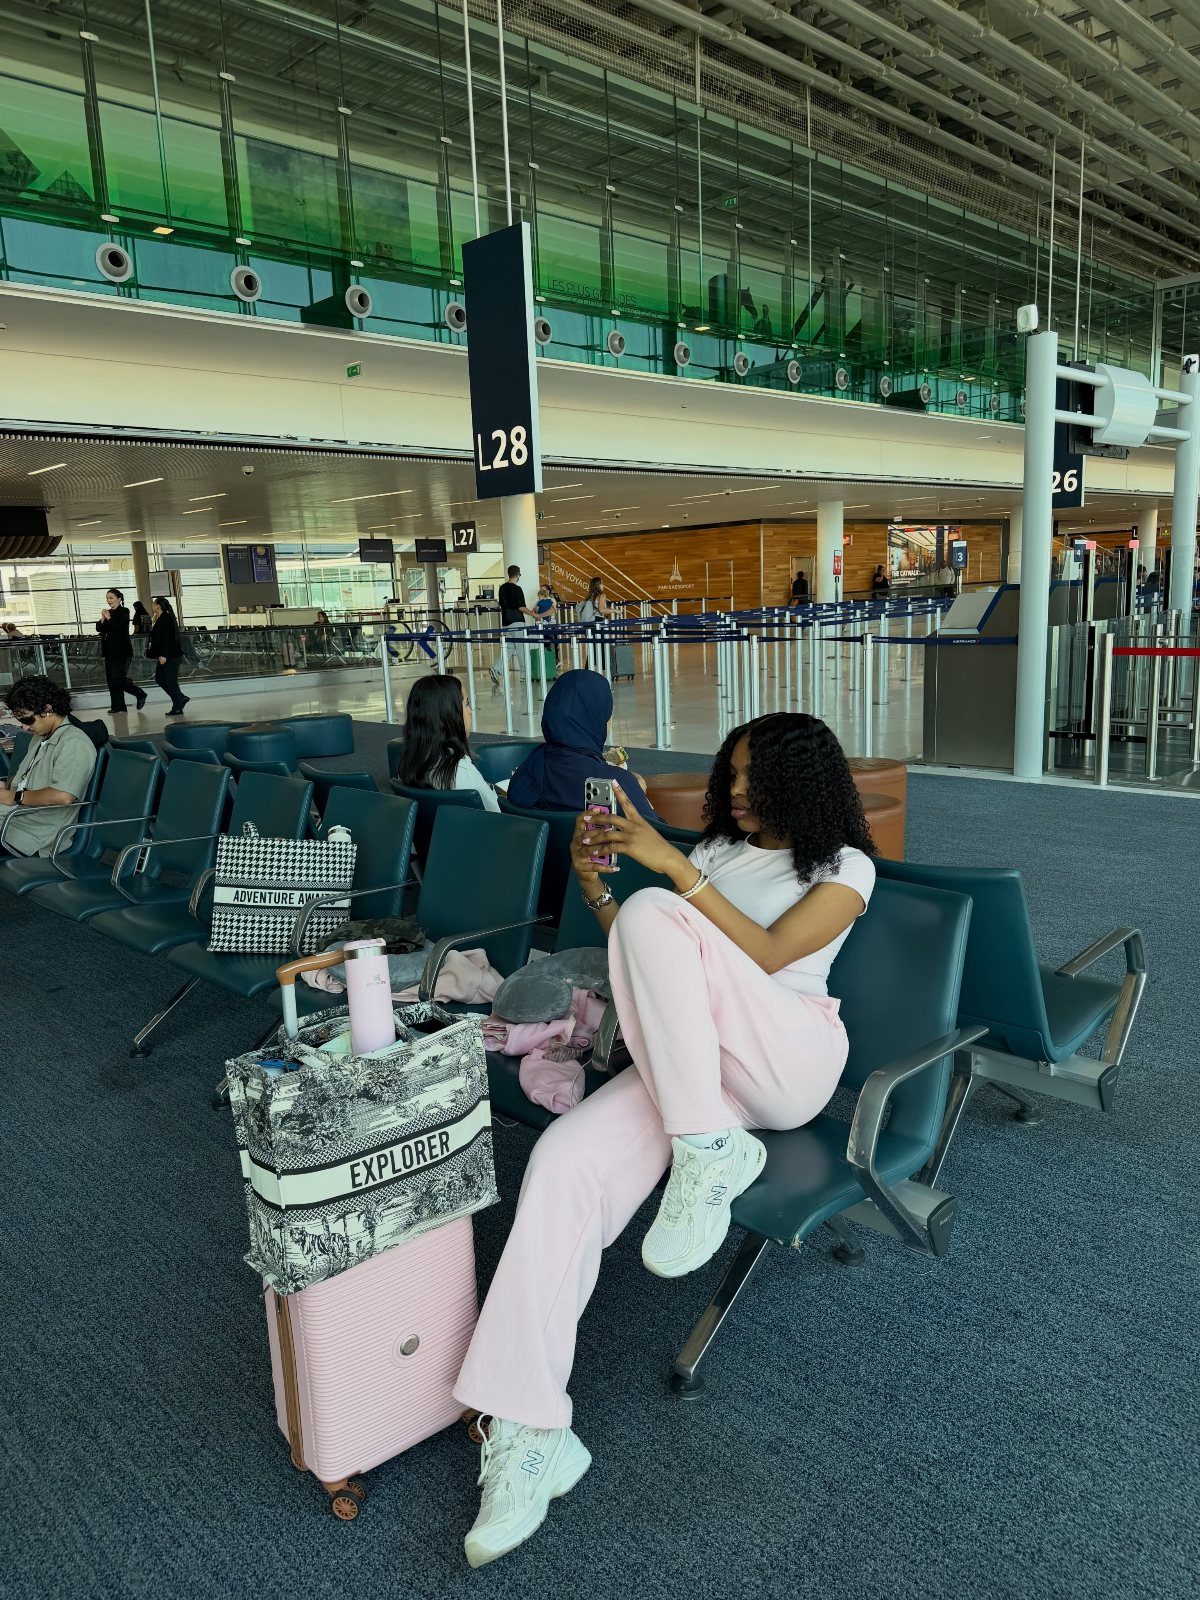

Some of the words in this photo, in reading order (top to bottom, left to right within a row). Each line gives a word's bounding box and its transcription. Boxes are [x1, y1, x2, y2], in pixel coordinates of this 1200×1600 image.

[547, 279, 564, 291] LES
[566, 282, 591, 298] PLUS
[593, 287, 638, 306] GNDES
[477, 425, 528, 471] L28
[454, 528, 474, 546] L27
[957, 552, 963, 562] 3
[233, 890, 295, 904] ADVENTURE
[350, 1130, 450, 1189] EXPLORER
[705, 1185, 728, 1206] N
[521, 1450, 545, 1476] N
